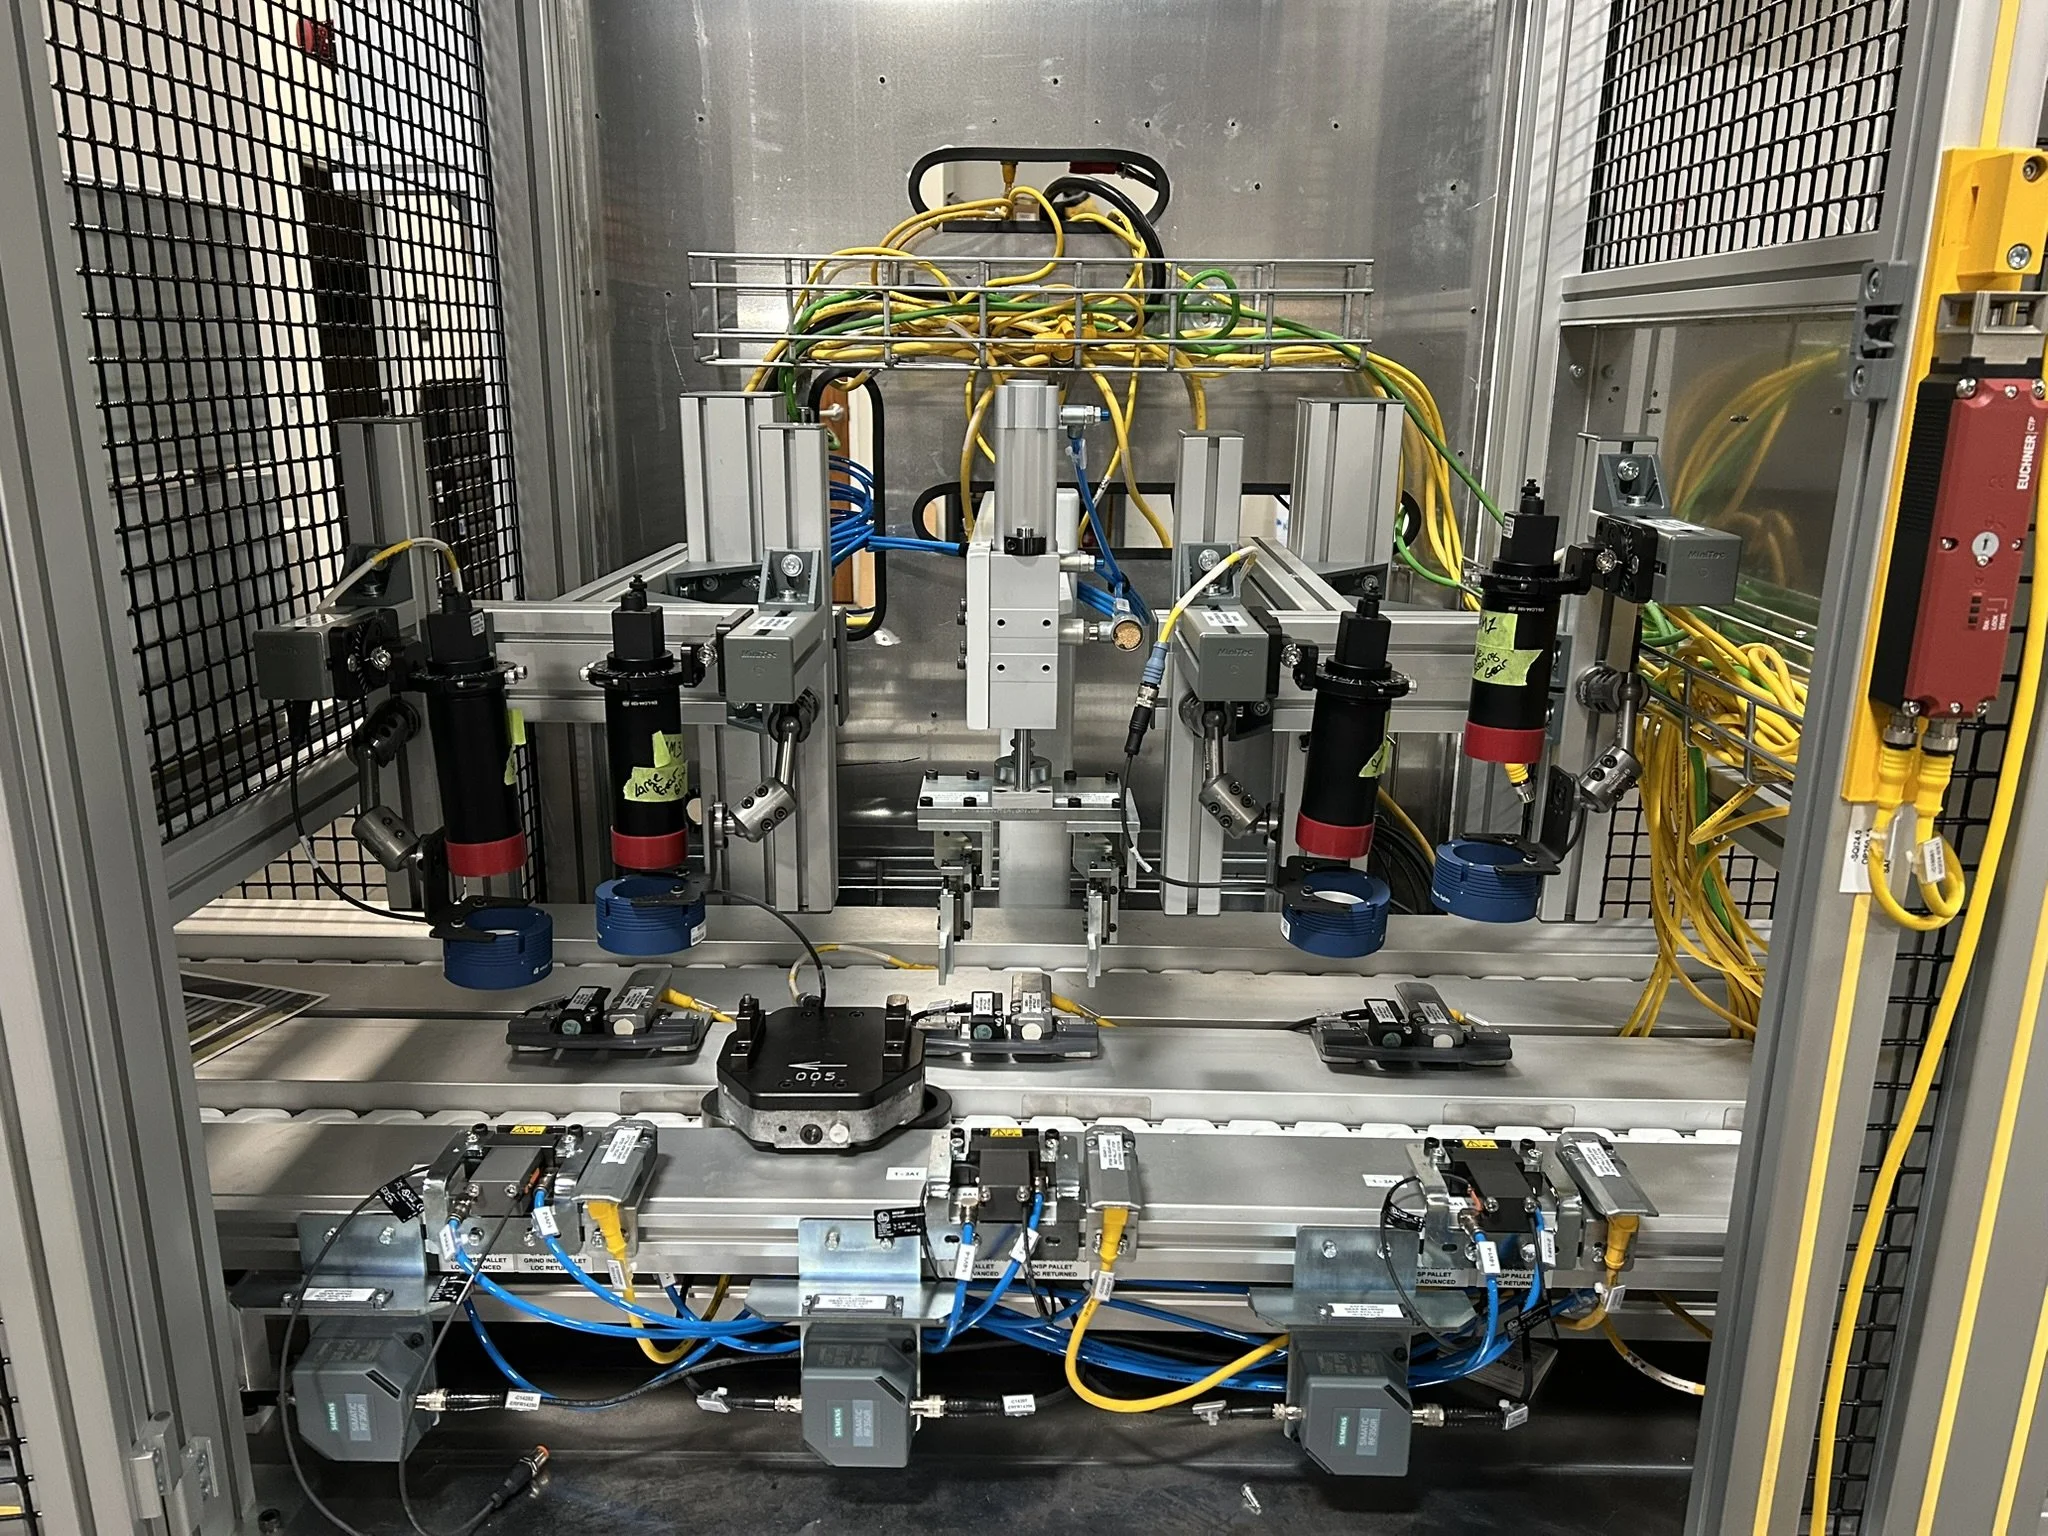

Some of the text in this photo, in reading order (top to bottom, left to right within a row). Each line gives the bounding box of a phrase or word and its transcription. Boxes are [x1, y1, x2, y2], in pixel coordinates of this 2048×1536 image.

[2016, 435, 2037, 490] EUCHNER
[796, 1072, 836, 1081] 005
[1420, 1279, 1457, 1287] ADVANCED
[1427, 1271, 1452, 1279] PALLET
[328, 1402, 338, 1431] SIEMENS
[833, 1407, 842, 1437] SIEMENS
[1338, 1416, 1348, 1446] SIEMENS
